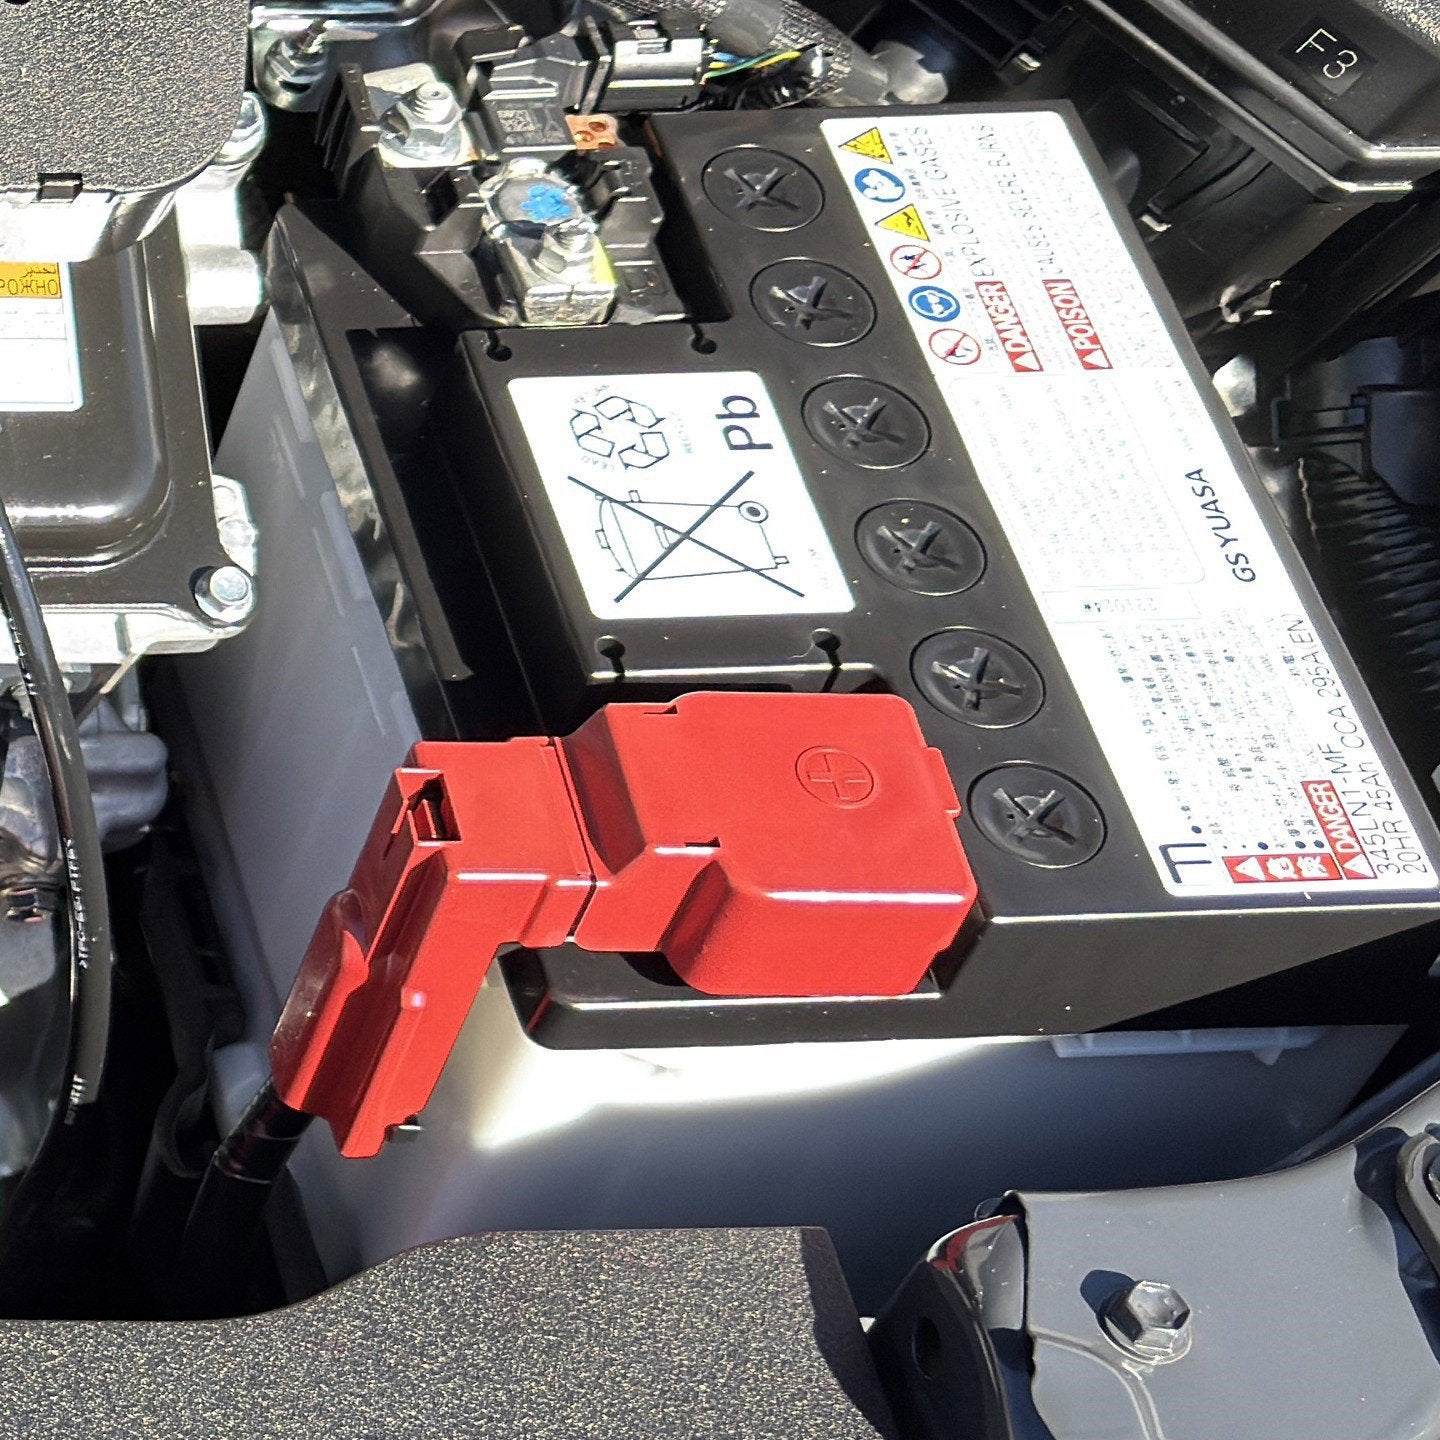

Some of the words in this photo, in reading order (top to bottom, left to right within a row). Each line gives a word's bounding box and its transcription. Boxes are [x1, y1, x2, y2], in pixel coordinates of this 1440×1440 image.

[1295, 28, 1358, 79] F3
[906, 126, 948, 181] GASES
[934, 186, 994, 277] EXPLOSIVE
[978, 281, 1029, 353] DANGER
[1047, 280, 1101, 351] POISON
[715, 395, 774, 450] Pb
[1185, 468, 1239, 548] YUASA
[1225, 552, 1257, 583] GS
[1281, 613, 1342, 699] 295A(EN)
[1328, 704, 1365, 750] CCA
[1306, 782, 1364, 854] DANGER
[1317, 742, 1401, 875] 345LN1-MF
[1358, 761, 1395, 812] 45Ah
[1382, 819, 1428, 875] 20HR
